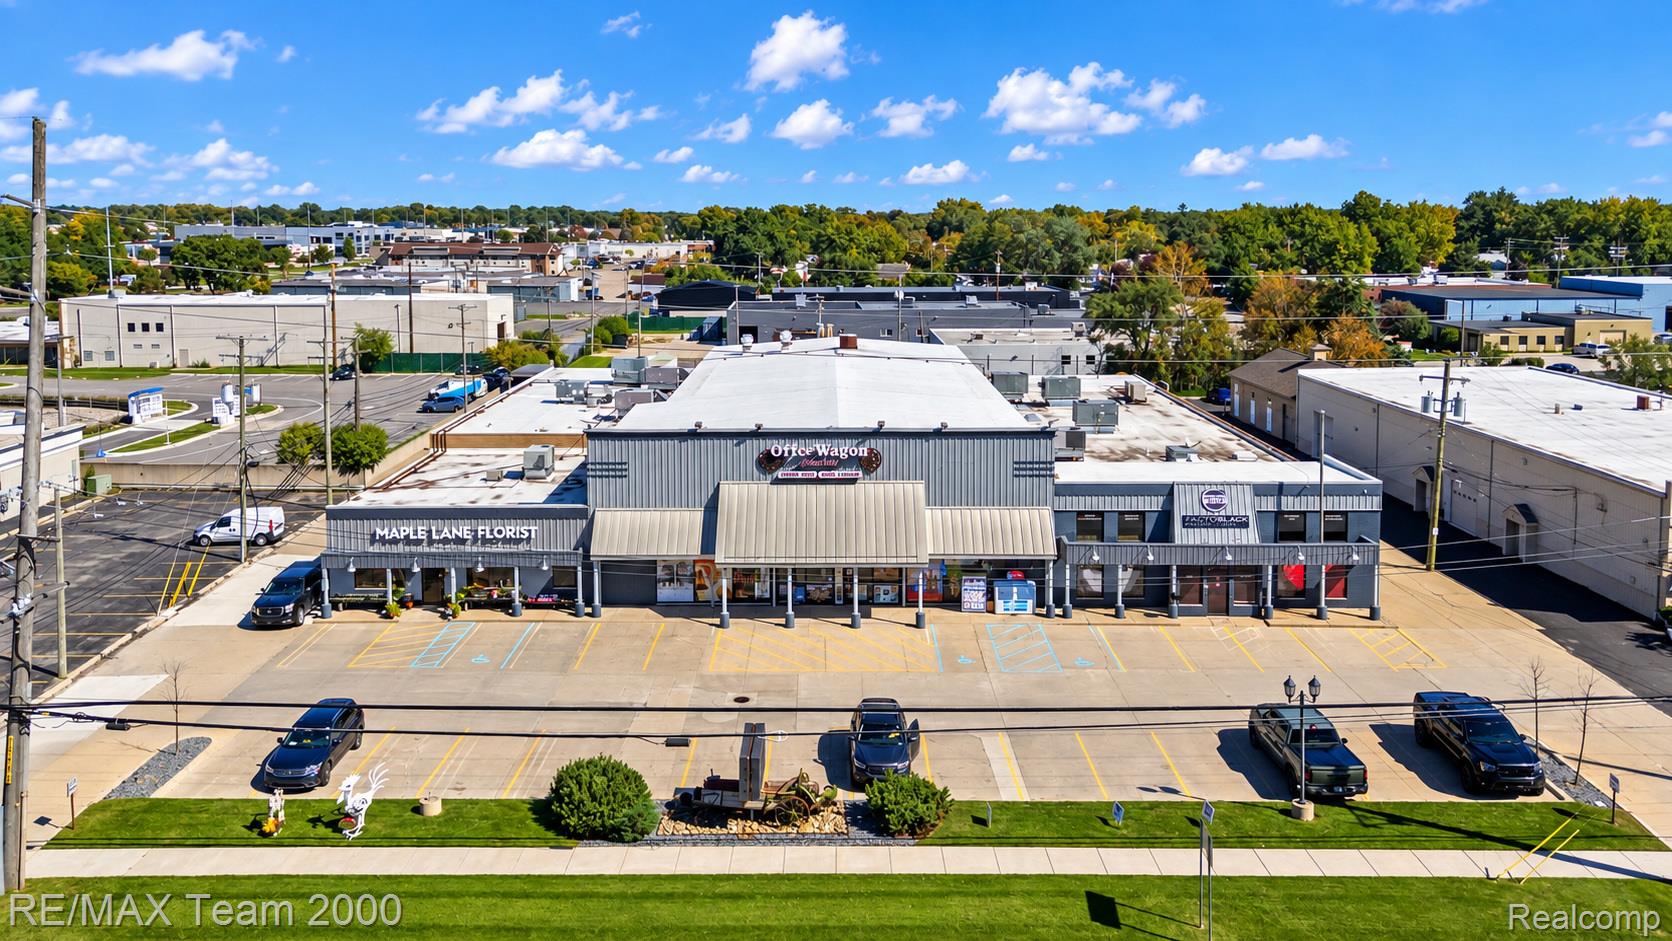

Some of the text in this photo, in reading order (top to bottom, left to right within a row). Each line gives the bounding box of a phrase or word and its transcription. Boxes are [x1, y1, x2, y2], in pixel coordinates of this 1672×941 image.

[813, 443, 868, 459] Wagon
[375, 525, 538, 540] MAPLE LANE FLORIST
